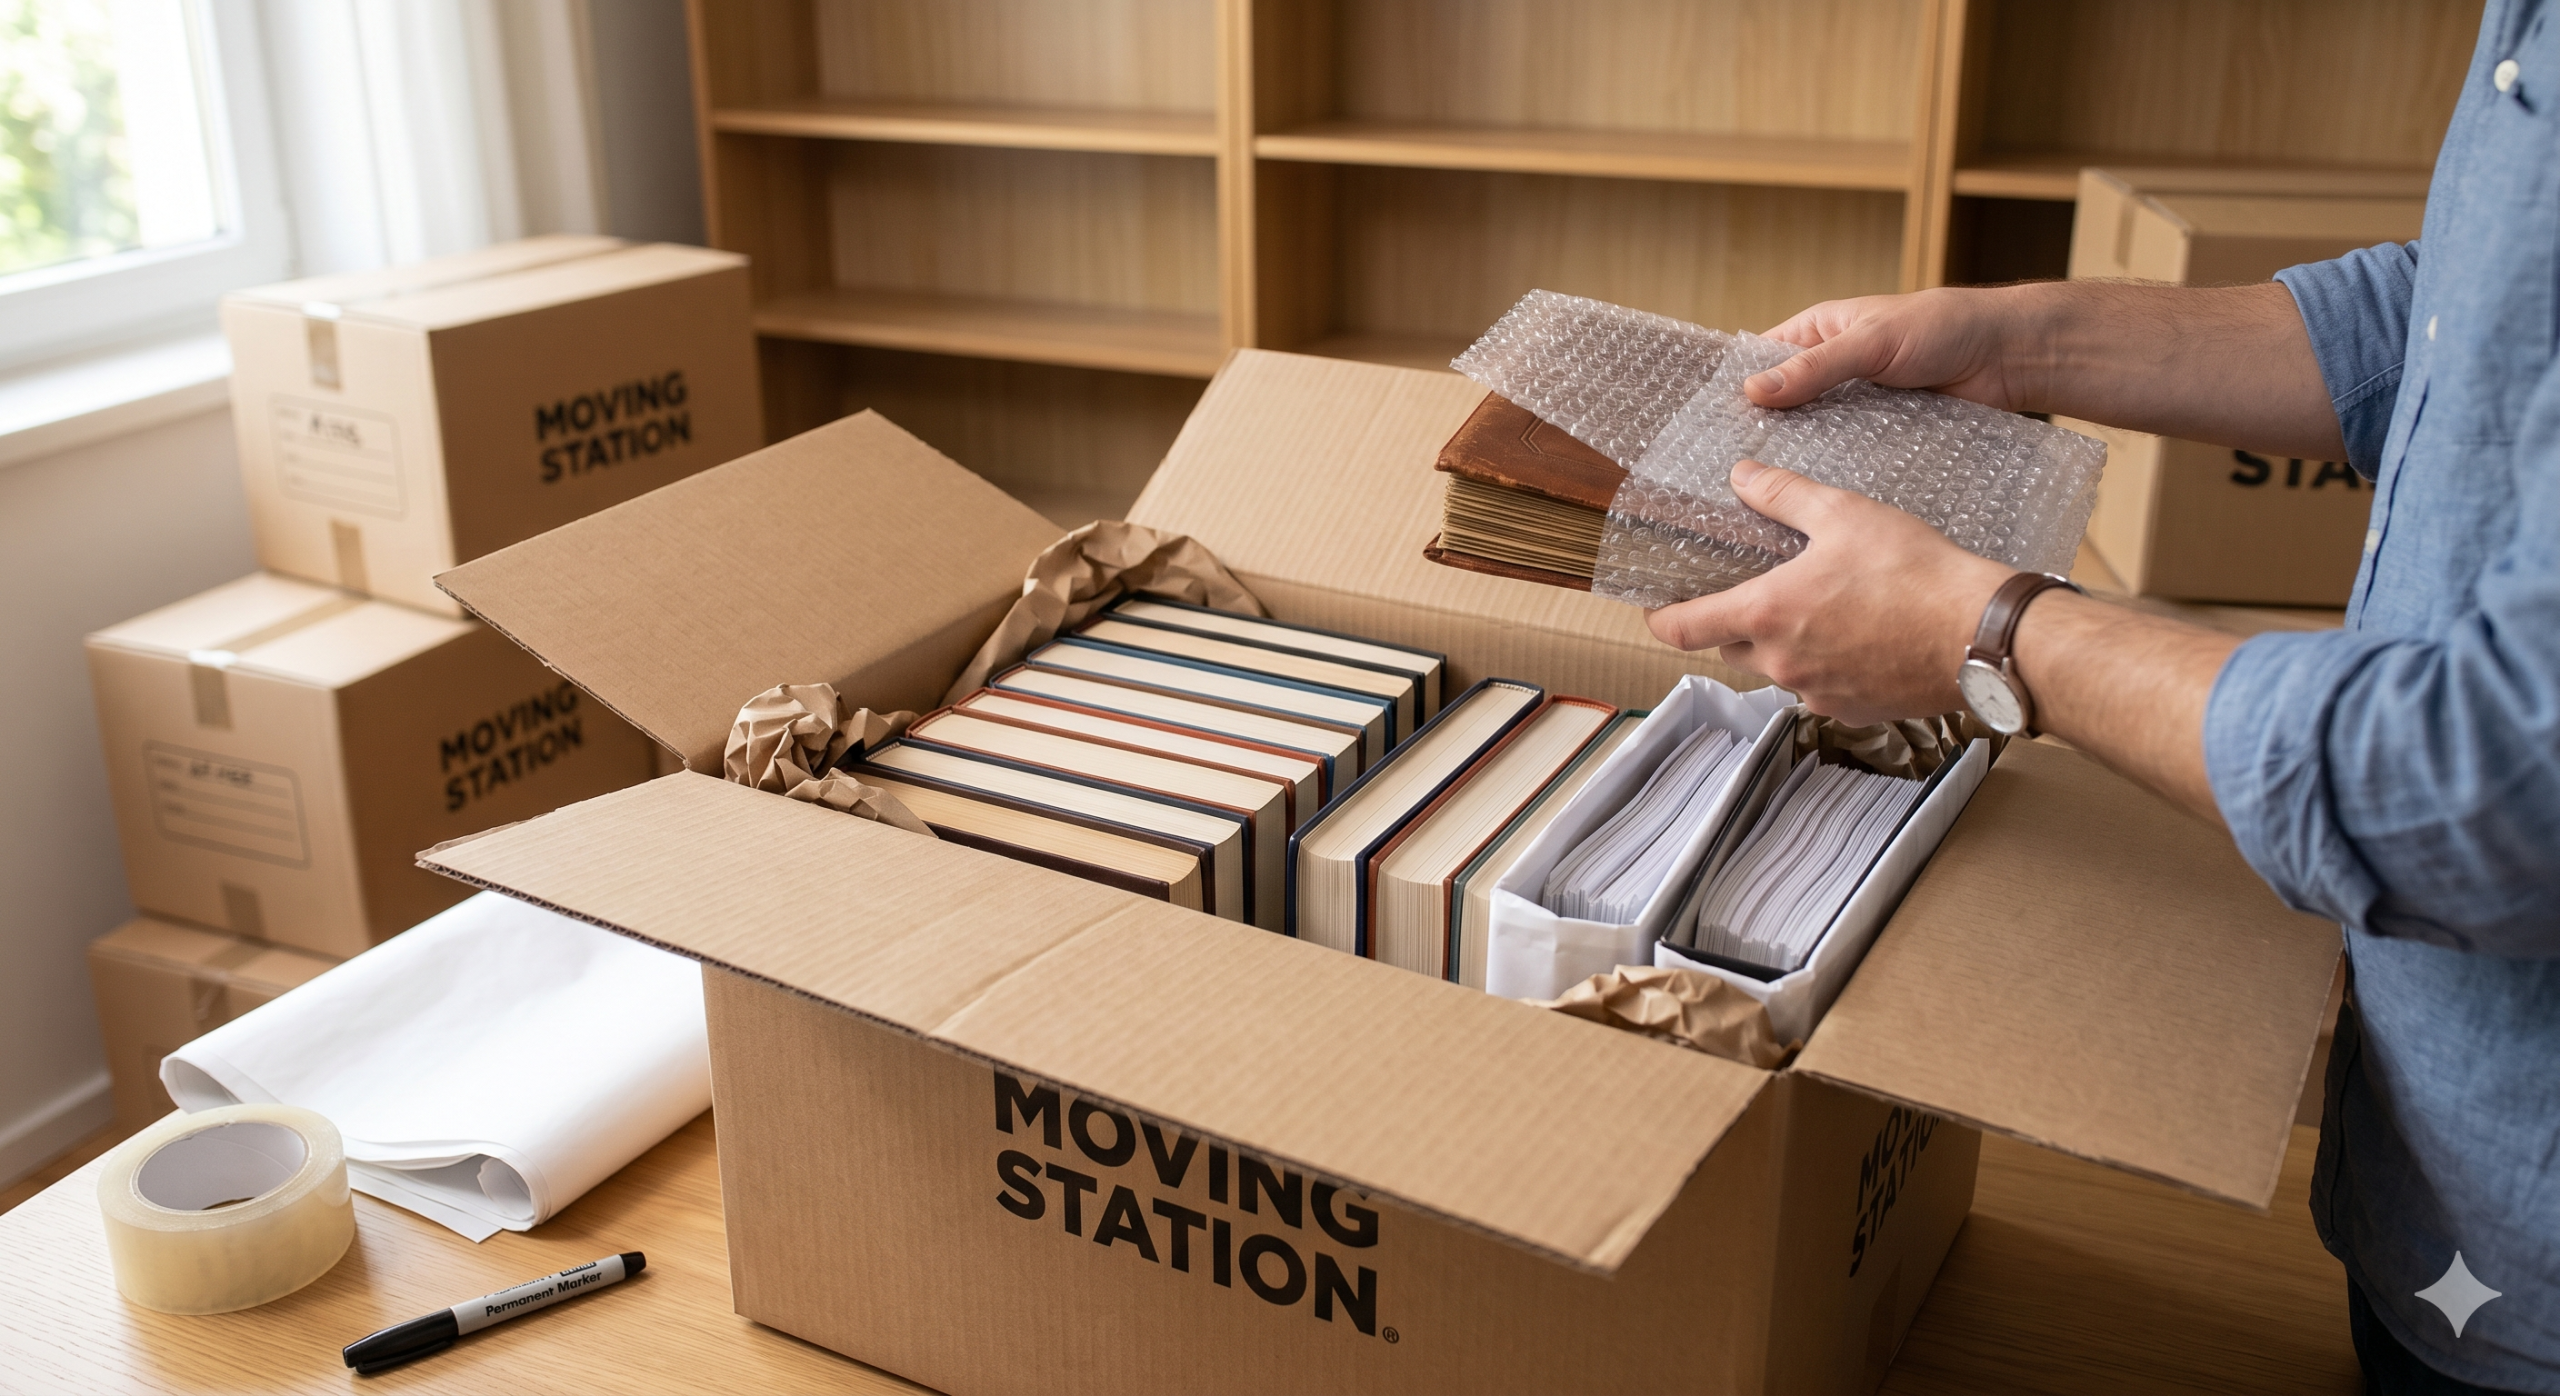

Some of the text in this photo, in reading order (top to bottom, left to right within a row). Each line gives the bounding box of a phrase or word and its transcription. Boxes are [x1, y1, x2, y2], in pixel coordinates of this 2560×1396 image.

[535, 369, 687, 441] MOVING
[541, 412, 692, 484] STATION
[440, 680, 578, 772] MOVING
[446, 719, 582, 813] STATION
[993, 1064, 1379, 1249] MOVING
[1849, 1113, 1940, 1278] STATIO
[485, 1287, 554, 1317] Permanent
[557, 1271, 602, 1293] Marker
